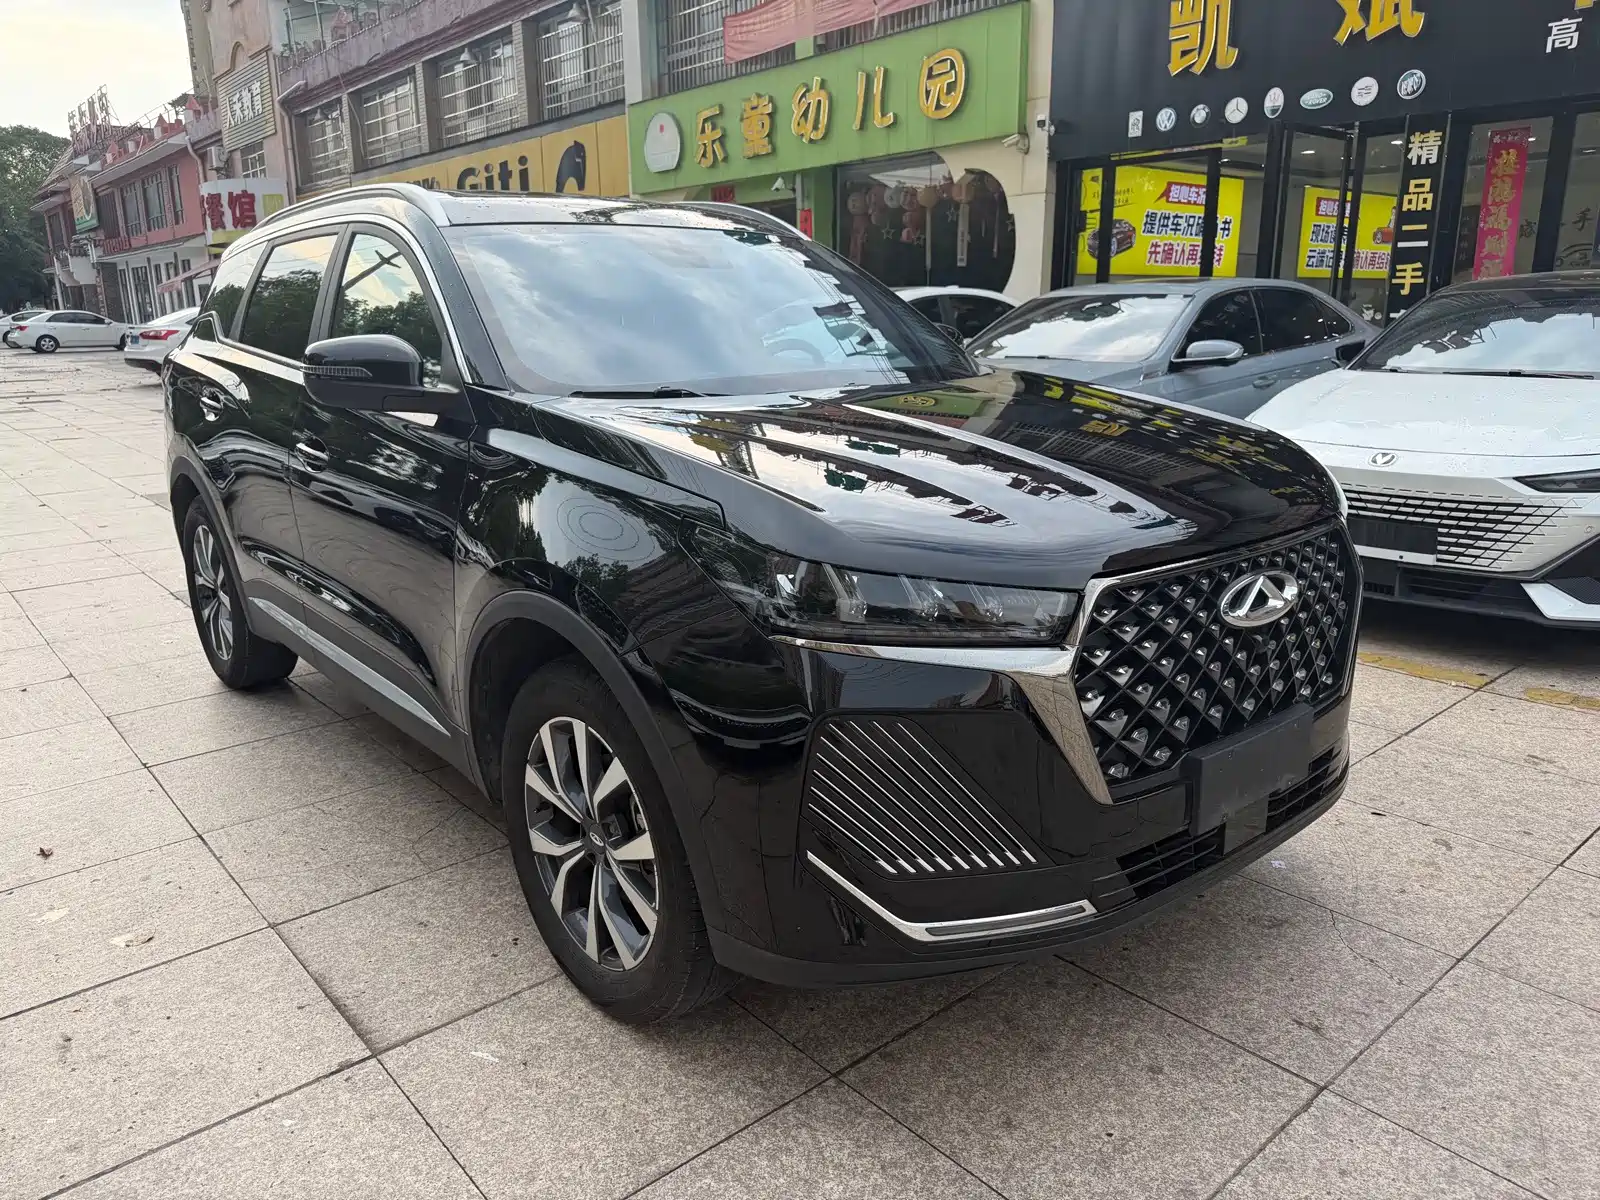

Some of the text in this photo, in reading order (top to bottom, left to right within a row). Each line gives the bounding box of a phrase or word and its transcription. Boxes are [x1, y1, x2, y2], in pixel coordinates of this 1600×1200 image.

[1545, 17, 1583, 53] 高
[694, 46, 967, 169] 乐童幼儿园
[457, 155, 530, 191] Giti
[201, 190, 257, 231] 餐馆
[1142, 210, 1232, 239] 提供车况确书
[1390, 130, 1442, 318] 精品二手
[1147, 241, 1224, 267] 先确认再钱
